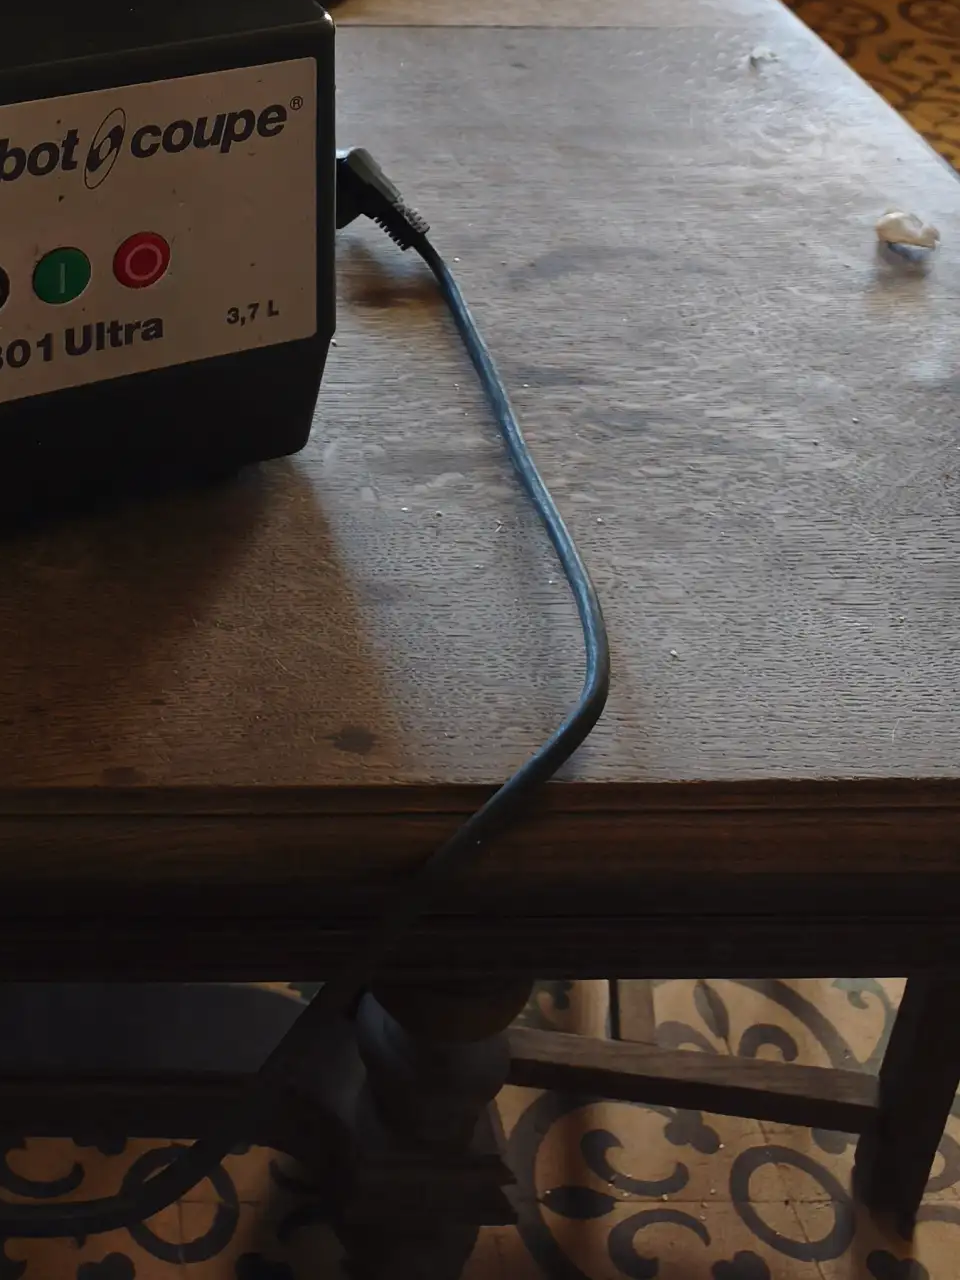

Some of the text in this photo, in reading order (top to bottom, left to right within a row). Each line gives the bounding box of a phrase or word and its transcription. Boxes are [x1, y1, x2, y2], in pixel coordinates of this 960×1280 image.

[226, 299, 280, 327] 3,7 L
[64, 316, 165, 357] Ultra
